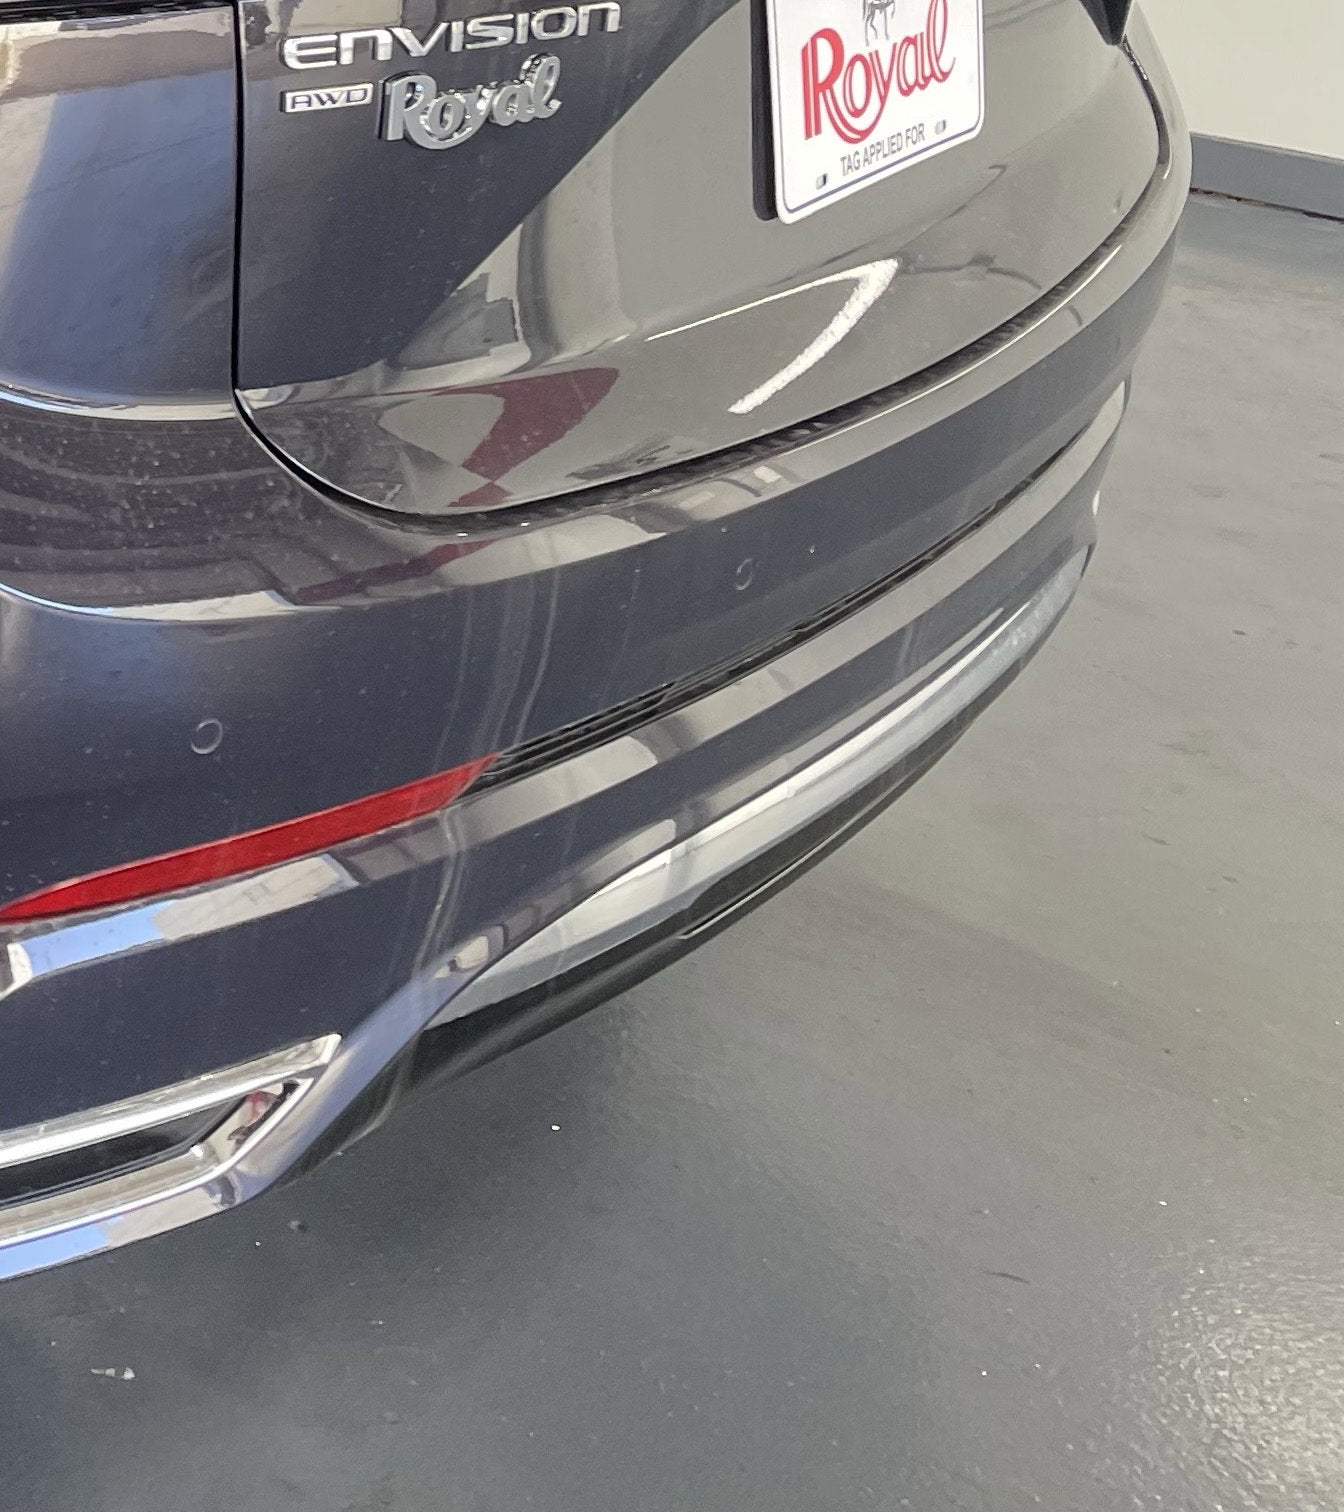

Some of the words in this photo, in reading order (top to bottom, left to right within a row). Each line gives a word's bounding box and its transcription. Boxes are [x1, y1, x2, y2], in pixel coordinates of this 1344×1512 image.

[282, 1, 621, 69] ENVISION
[289, 86, 369, 110] AWD
[379, 53, 561, 149] Royal
[840, 151, 861, 176] TAG
[863, 132, 903, 167] APPLIED
[905, 123, 925, 147] FOR
